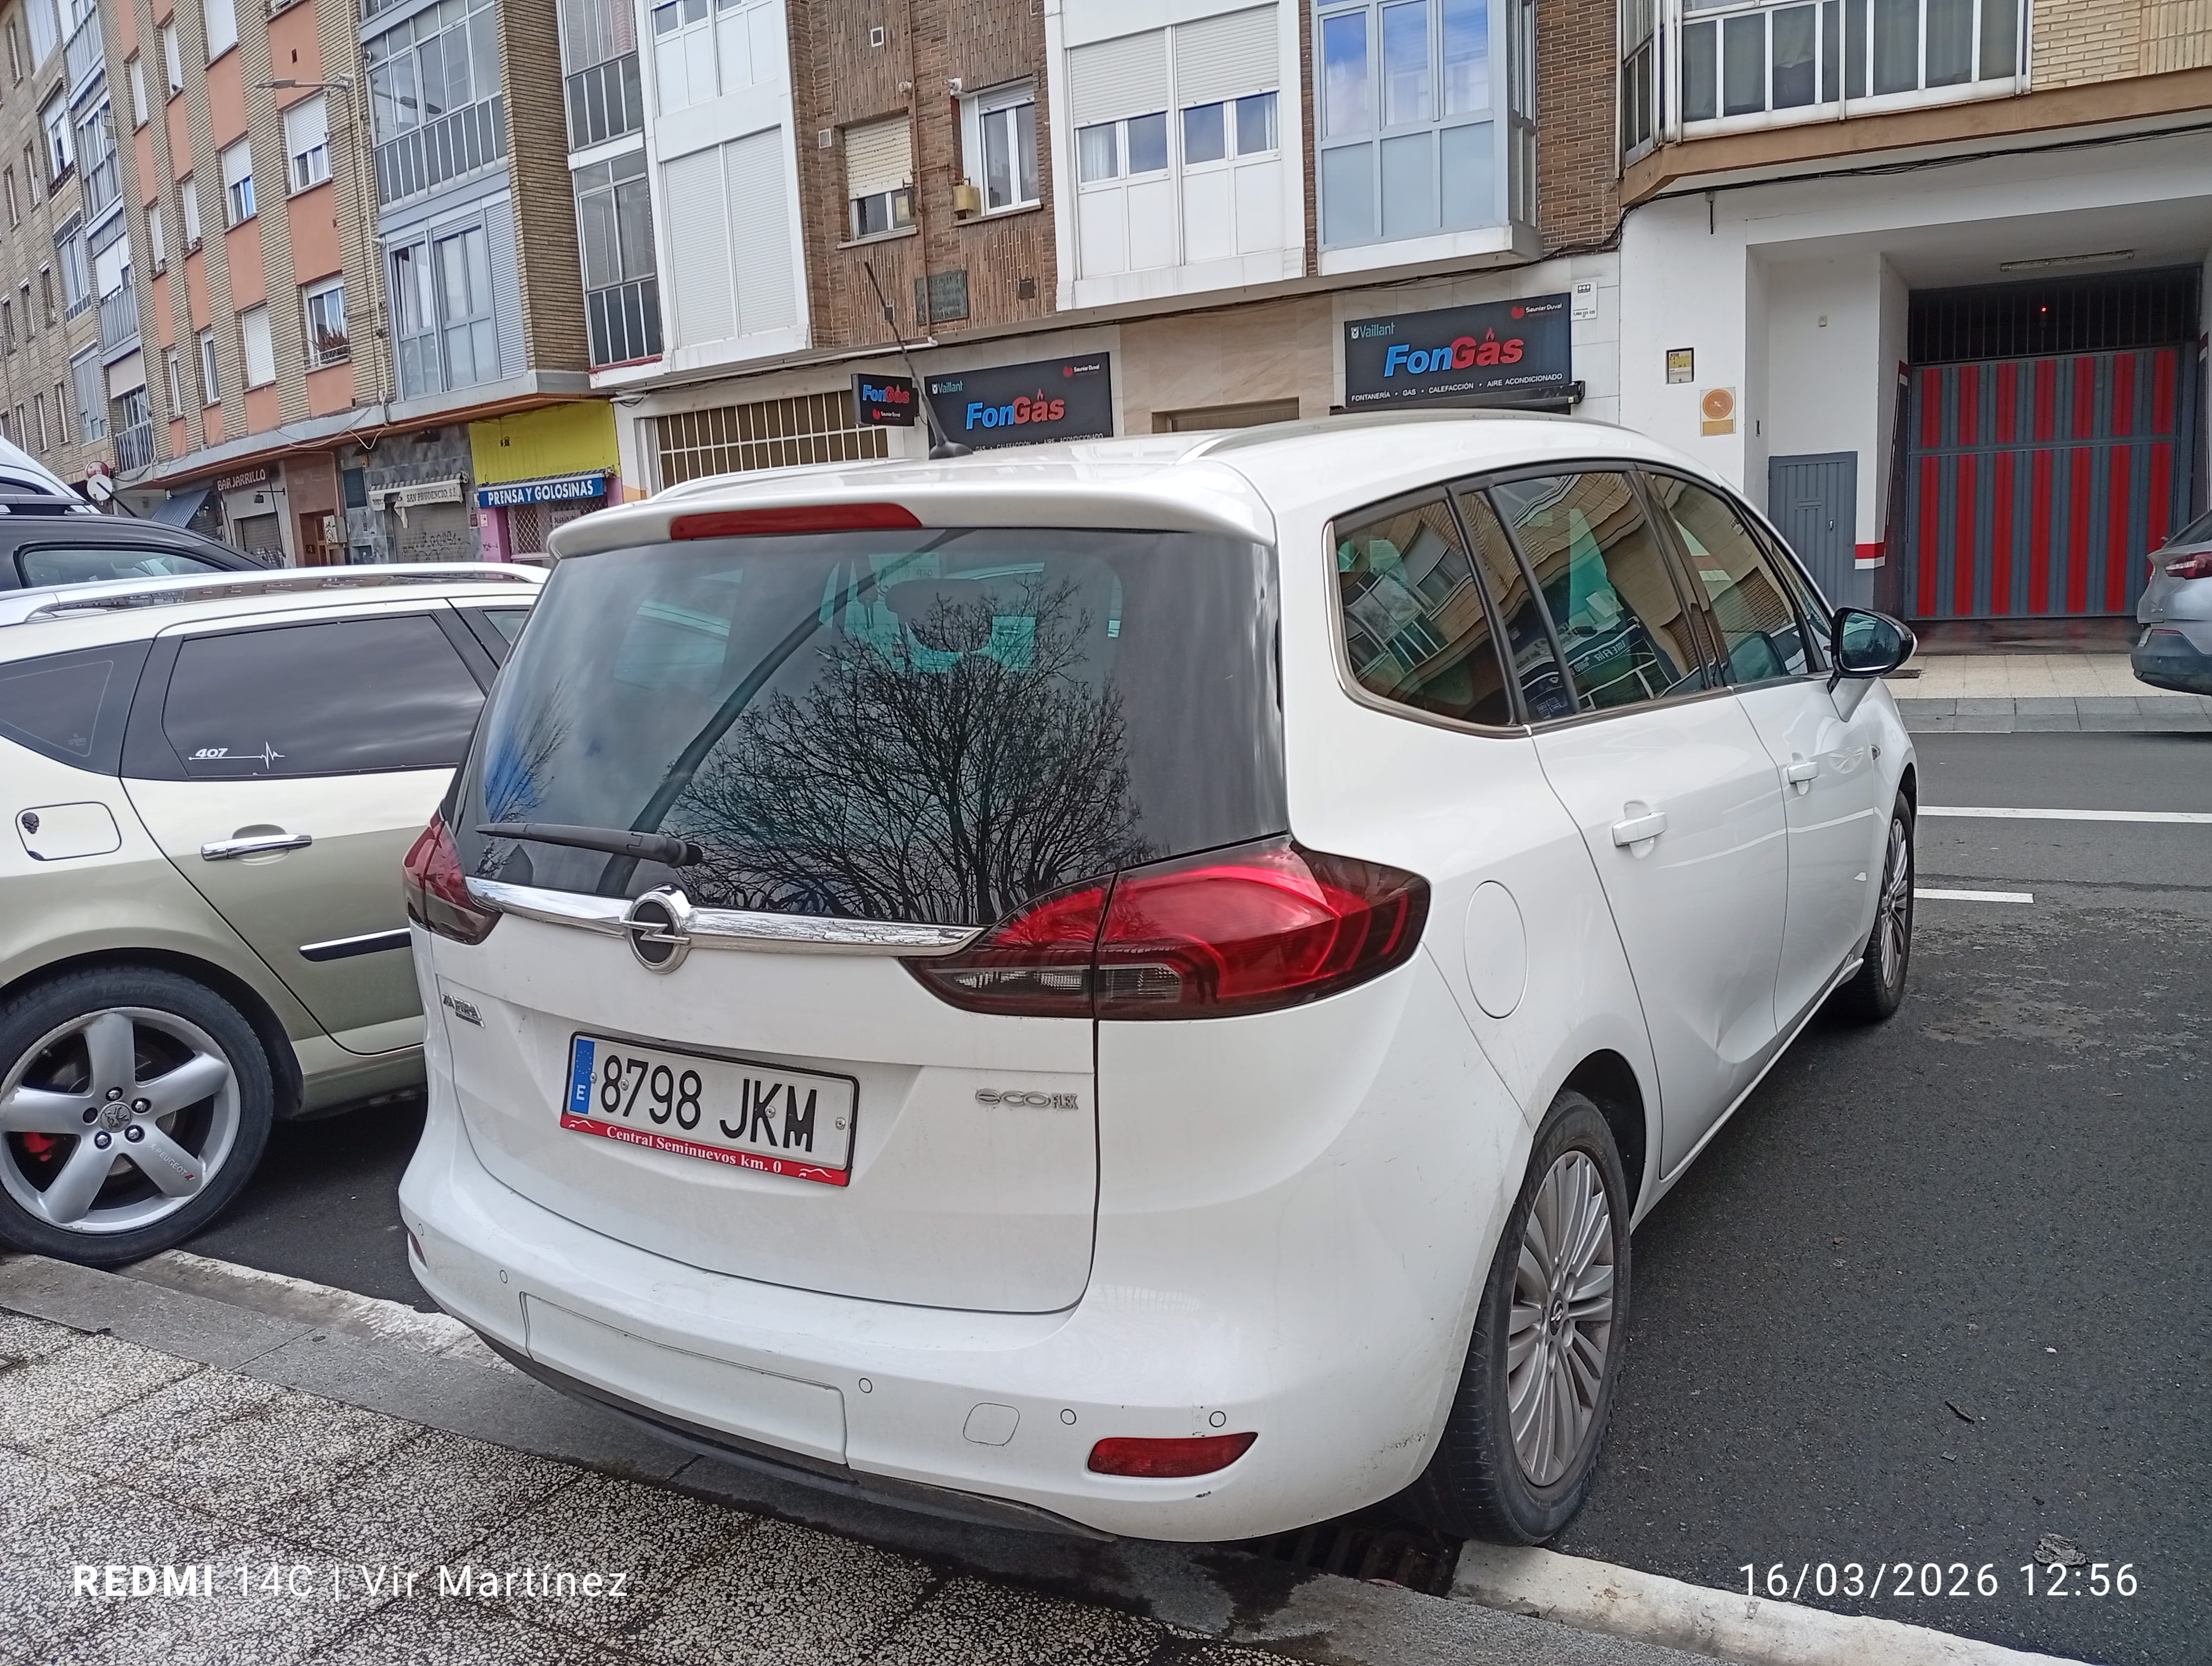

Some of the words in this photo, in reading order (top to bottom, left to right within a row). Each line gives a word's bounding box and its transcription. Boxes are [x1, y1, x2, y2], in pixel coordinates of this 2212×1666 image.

[195, 206, 228, 215] 407
[1359, 323, 1396, 338] Vaillant
[937, 380, 963, 393] Vaillant
[1352, 390, 1391, 402] FONTANERÍA
[1403, 388, 1416, 396] GAS
[1429, 382, 1474, 394] CALEFACCIÓN
[1487, 379, 1503, 387] AIRE
[1505, 373, 1562, 385] ACONDICIONADO
[217, 477, 232, 491] BAR
[233, 469, 266, 488] JARRILLO
[407, 492, 417, 502] SAN
[488, 489, 524, 505] PRENSA
[525, 487, 532, 502] Y
[535, 479, 594, 500] GOLOSINAS
[576, 1085, 586, 1101] E
[600, 1054, 703, 1130] 8798
[719, 1078, 818, 1152] JKM
[606, 1126, 653, 1147] Central
[656, 1131, 736, 1164] Seminuevos
[741, 1154, 768, 1171] km.
[773, 1161, 782, 1174] 0
[156, 1148, 188, 1175] PEUGEOT
